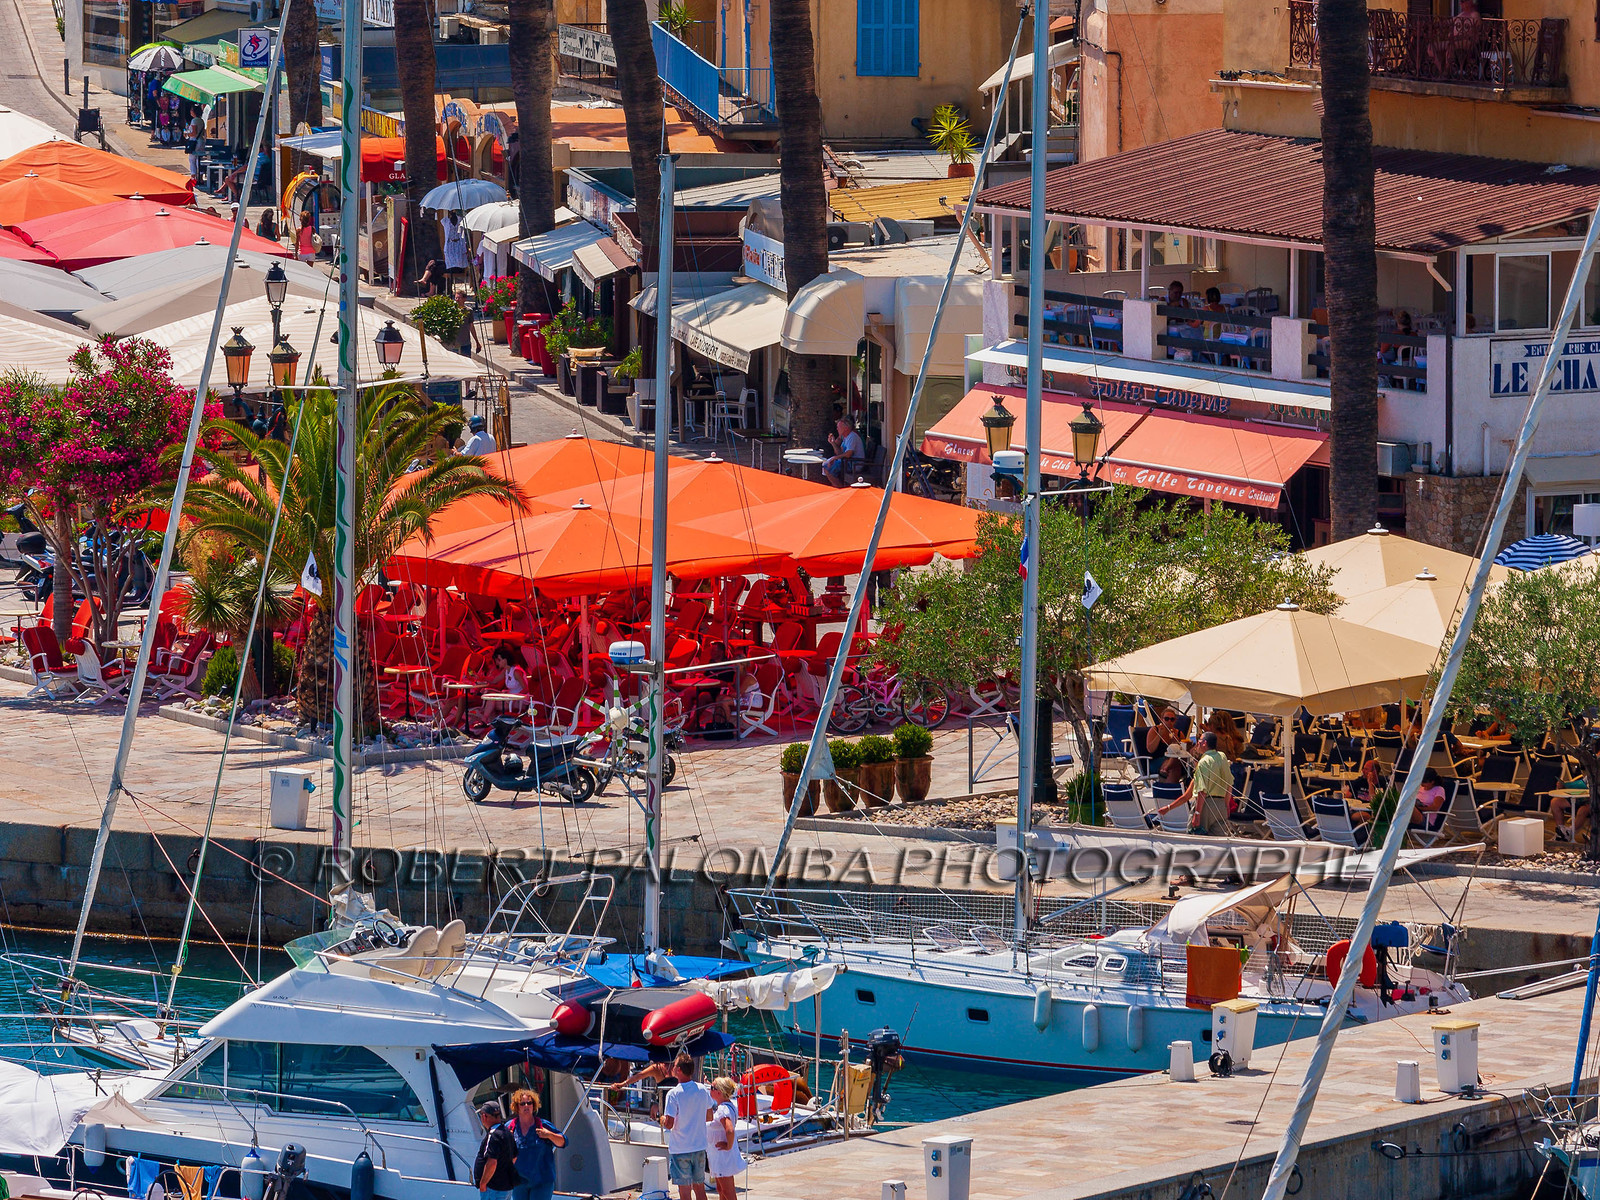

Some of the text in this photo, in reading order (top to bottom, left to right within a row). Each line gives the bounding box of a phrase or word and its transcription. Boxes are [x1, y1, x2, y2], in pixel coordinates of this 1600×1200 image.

[388, 172, 406, 180] GLA
[1568, 342, 1585, 354] RUE
[1494, 362, 1529, 394] LE
[944, 442, 974, 458] Glaces
[1052, 460, 1070, 471] Club
[1136, 470, 1276, 504] Golfe Taverne Cocktails
